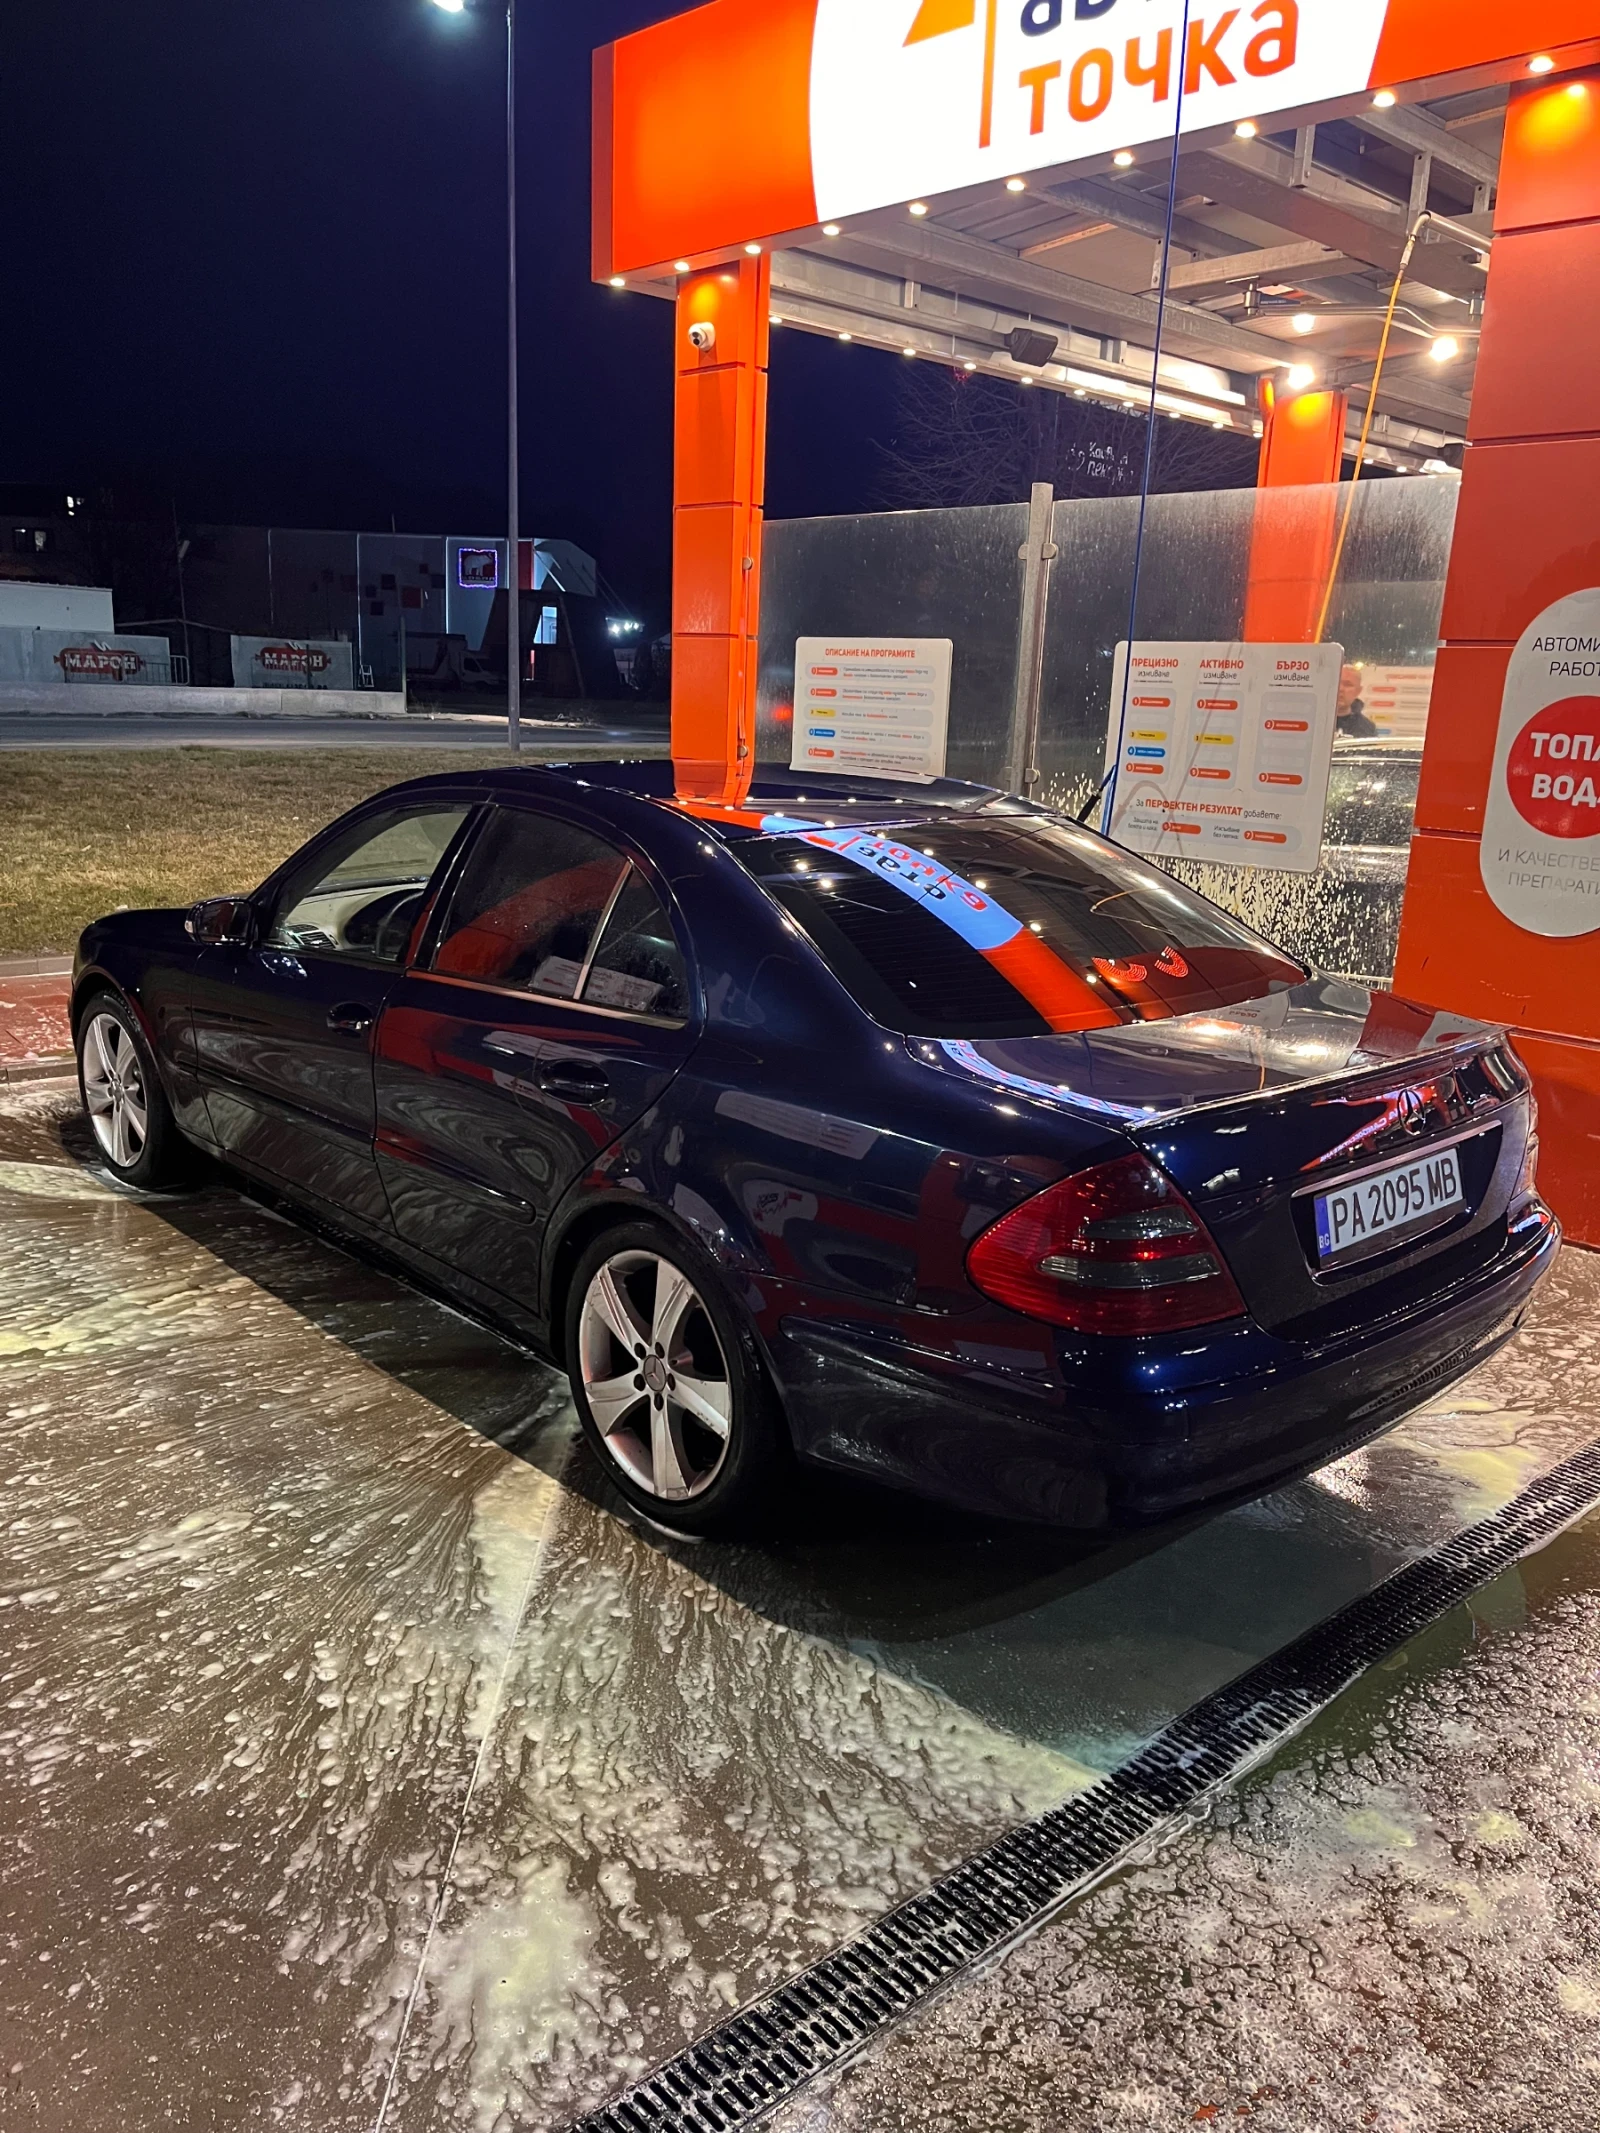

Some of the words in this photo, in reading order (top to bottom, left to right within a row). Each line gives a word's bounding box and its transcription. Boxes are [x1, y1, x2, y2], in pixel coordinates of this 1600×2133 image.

[1018, 0, 1299, 135] точка
[264, 652, 324, 668] МАРОН
[825, 648, 860, 657] ОПИСАНИЕ
[860, 648, 870, 657] НА
[870, 649, 916, 659] ПРОГРАМИТЕ
[64, 653, 137, 670] МАРОН
[1131, 657, 1179, 669] ПРЕЦИЗНО
[1199, 659, 1244, 670] АКТИВНО
[1276, 660, 1310, 671] БЪРЗО
[1203, 671, 1238, 680] измиване
[1273, 672, 1310, 682] измиване
[1531, 773, 1600, 808] ВОД
[1135, 798, 1144, 807] За
[1145, 799, 1198, 812] ПЕРФЕКТЕН
[1199, 803, 1243, 817] РЕЗУЛТАТ
[1243, 810, 1282, 821] добавете:
[1332, 1191, 1366, 1244] PA
[1368, 1167, 1424, 1229] 2095
[1426, 1157, 1457, 1206] MB
[1318, 1235, 1330, 1249] BG
